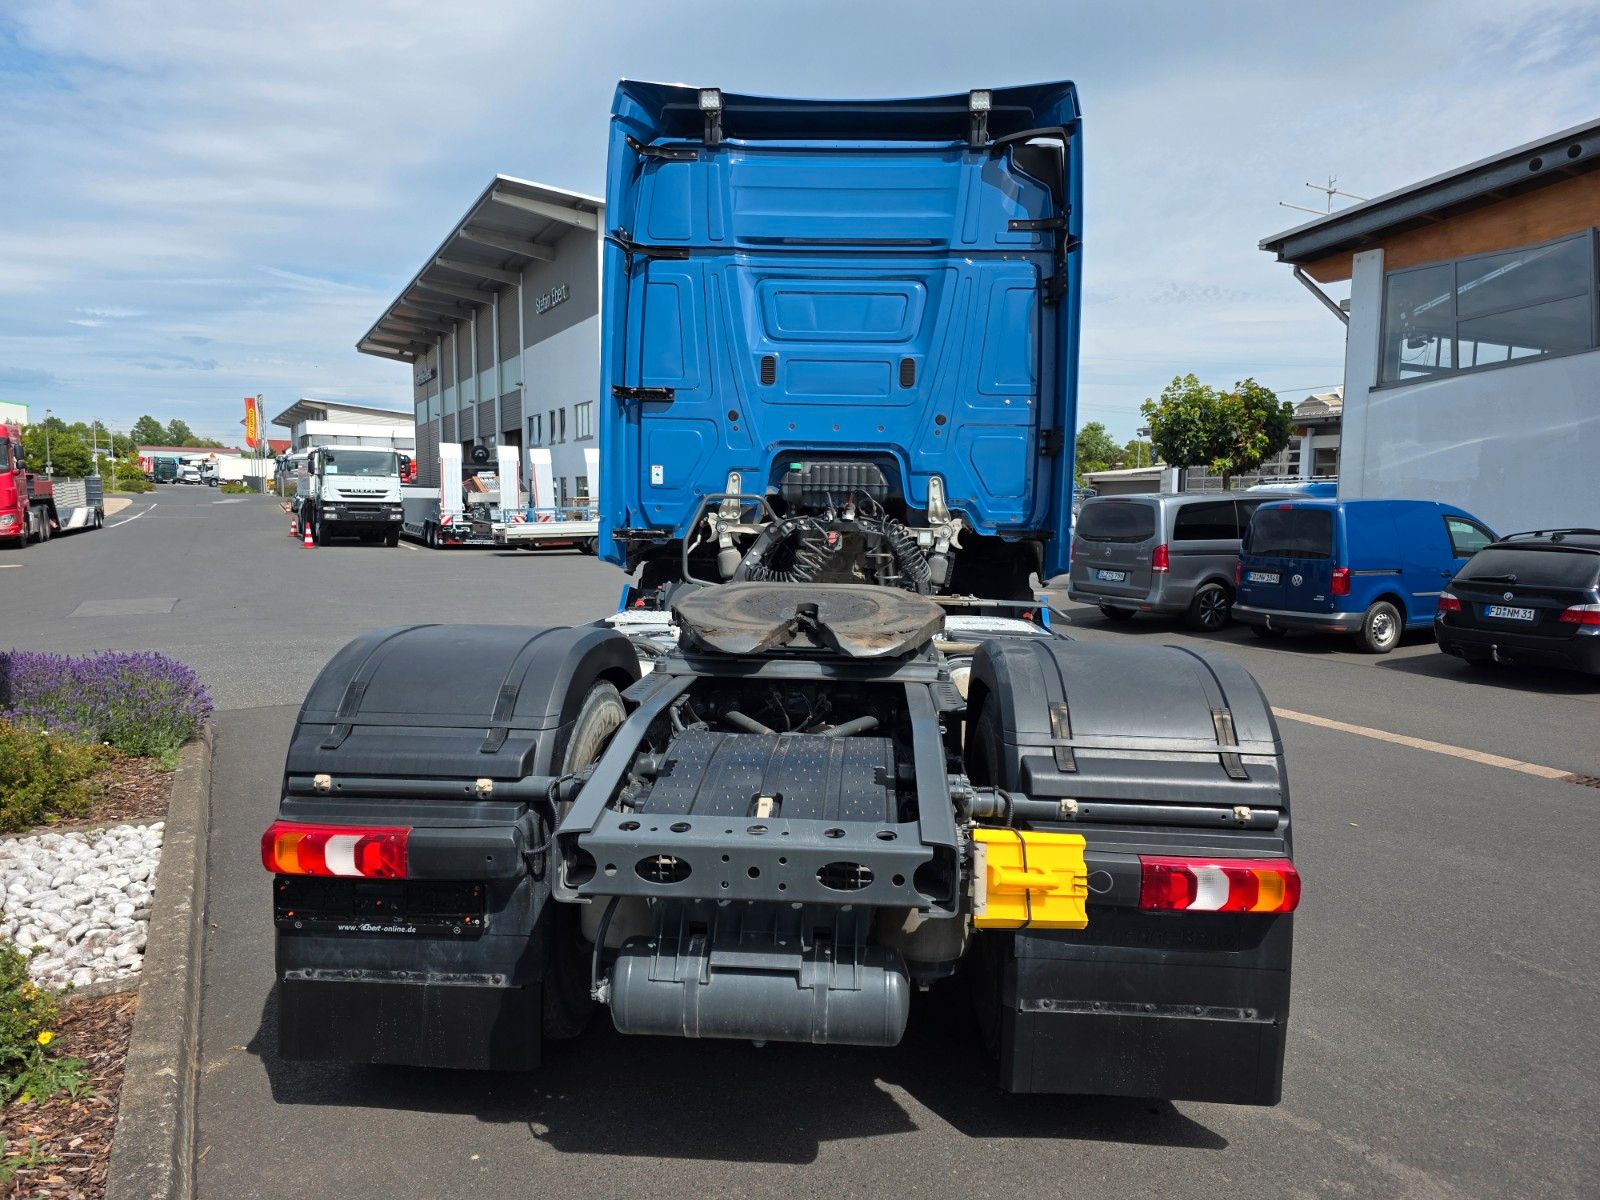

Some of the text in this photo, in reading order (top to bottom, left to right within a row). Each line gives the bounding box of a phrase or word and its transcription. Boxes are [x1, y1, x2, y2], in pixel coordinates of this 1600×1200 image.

[535, 282, 567, 315] Stefan Ebert
[1490, 606, 1533, 620] FD NM 31
